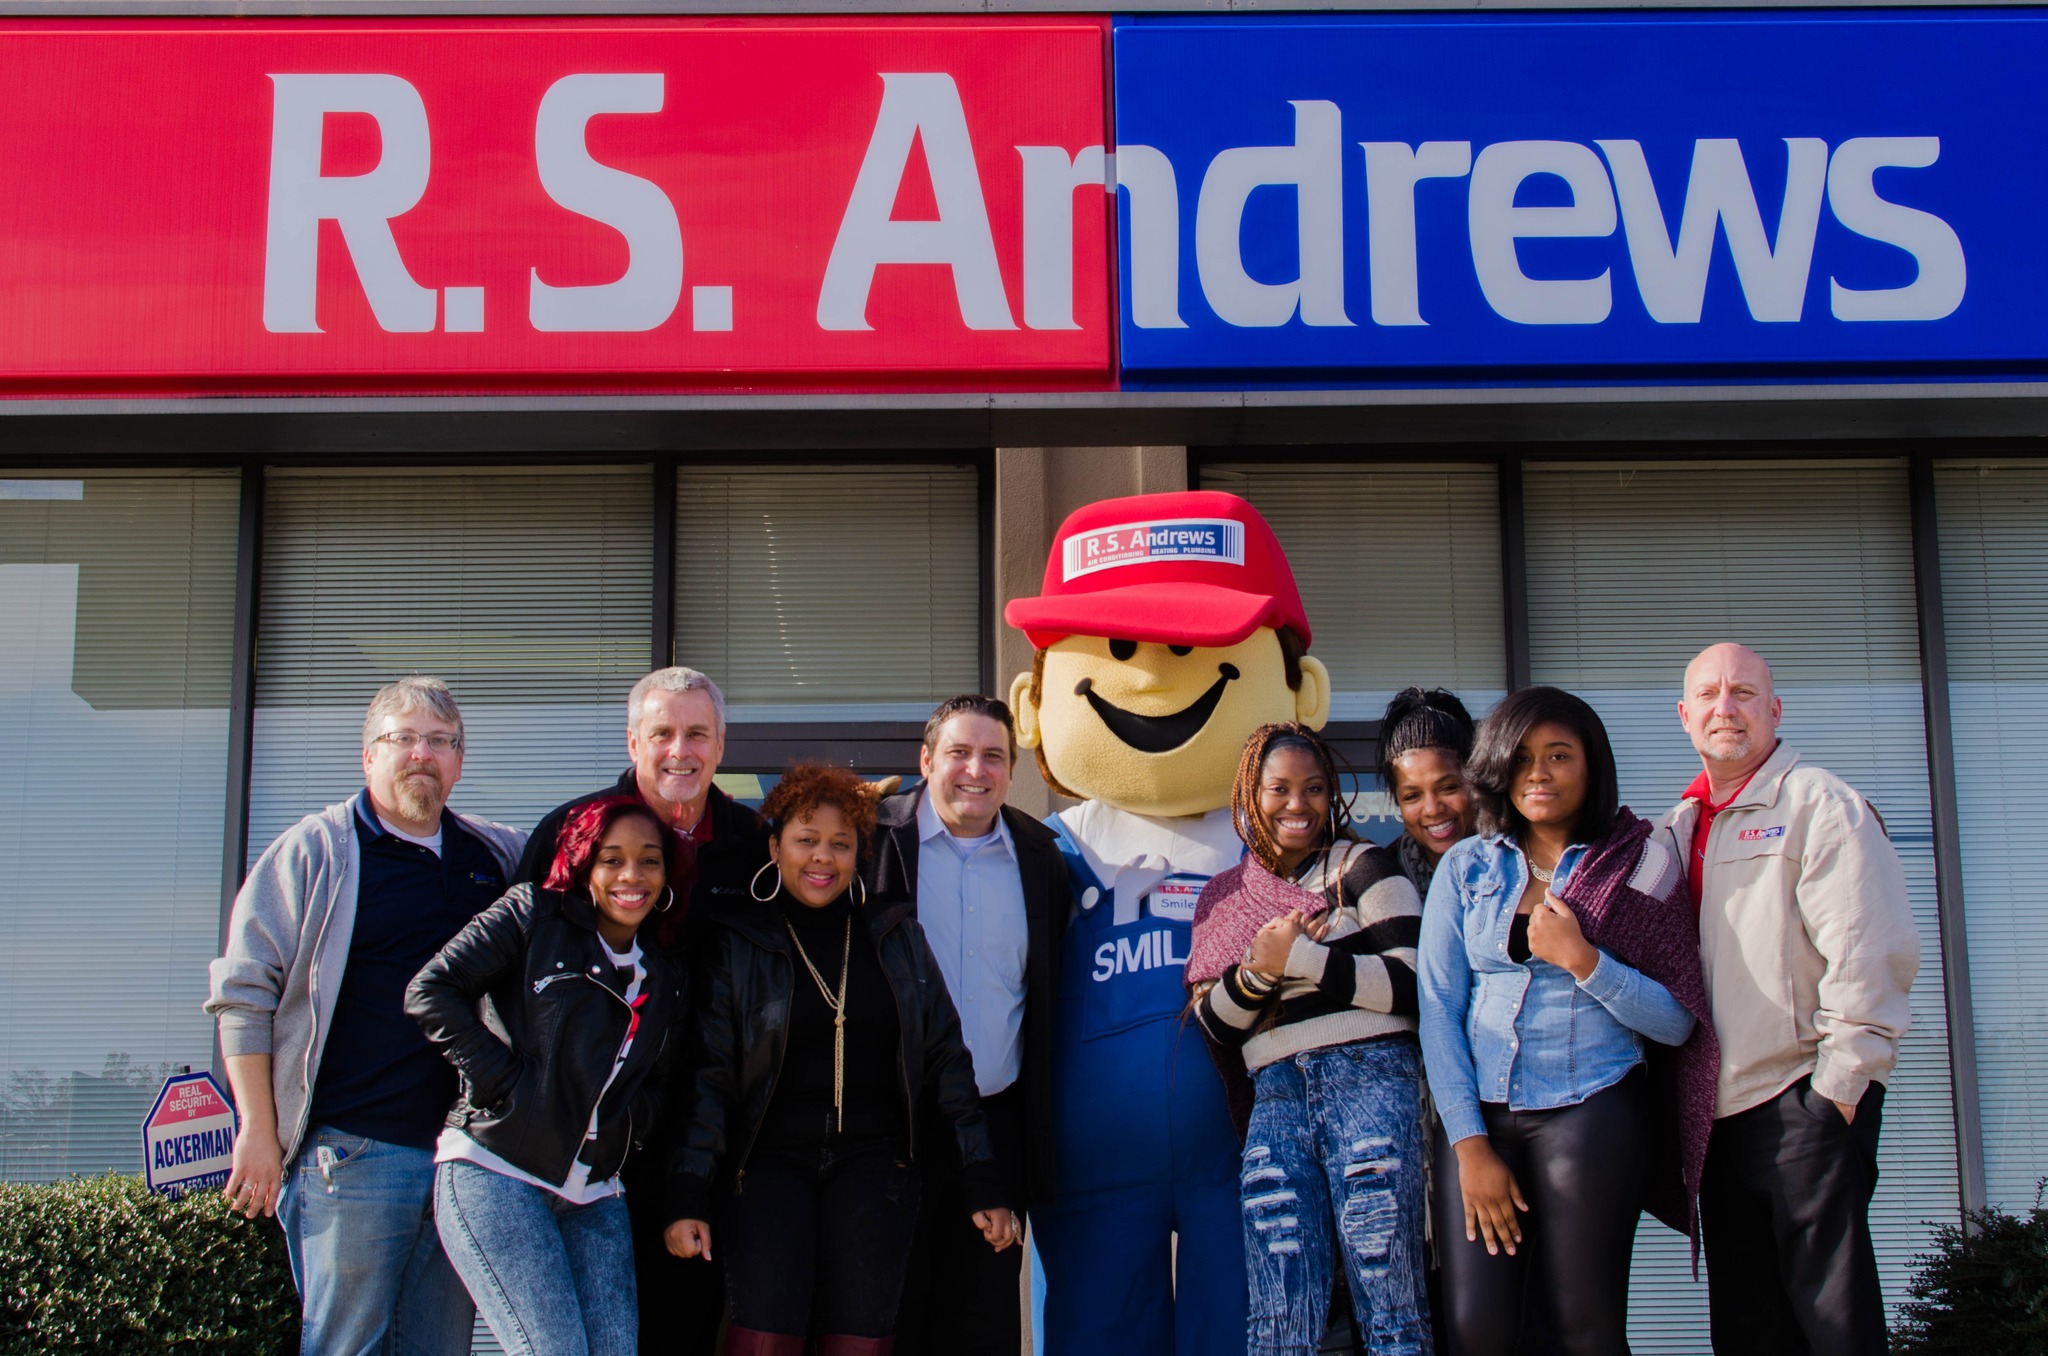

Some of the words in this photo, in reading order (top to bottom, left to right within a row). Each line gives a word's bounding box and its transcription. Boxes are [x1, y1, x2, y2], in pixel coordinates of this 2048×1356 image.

[264, 73, 733, 332] R.S.
[816, 72, 1967, 331] Andrews
[1087, 534, 1125, 558] R.S.
[1130, 529, 1216, 549] Andrews
[1088, 559, 1098, 567] AIR
[1099, 550, 1145, 563] CONDITIONING
[1151, 547, 1178, 555] HEATING
[1182, 547, 1217, 555] PLUMBING
[1161, 898, 1198, 909] Smile
[1092, 930, 1188, 982] SMIL
[179, 1084, 202, 1099] REAL
[188, 1109, 197, 1117] BY
[155, 1127, 233, 1170] ACKERMAN
